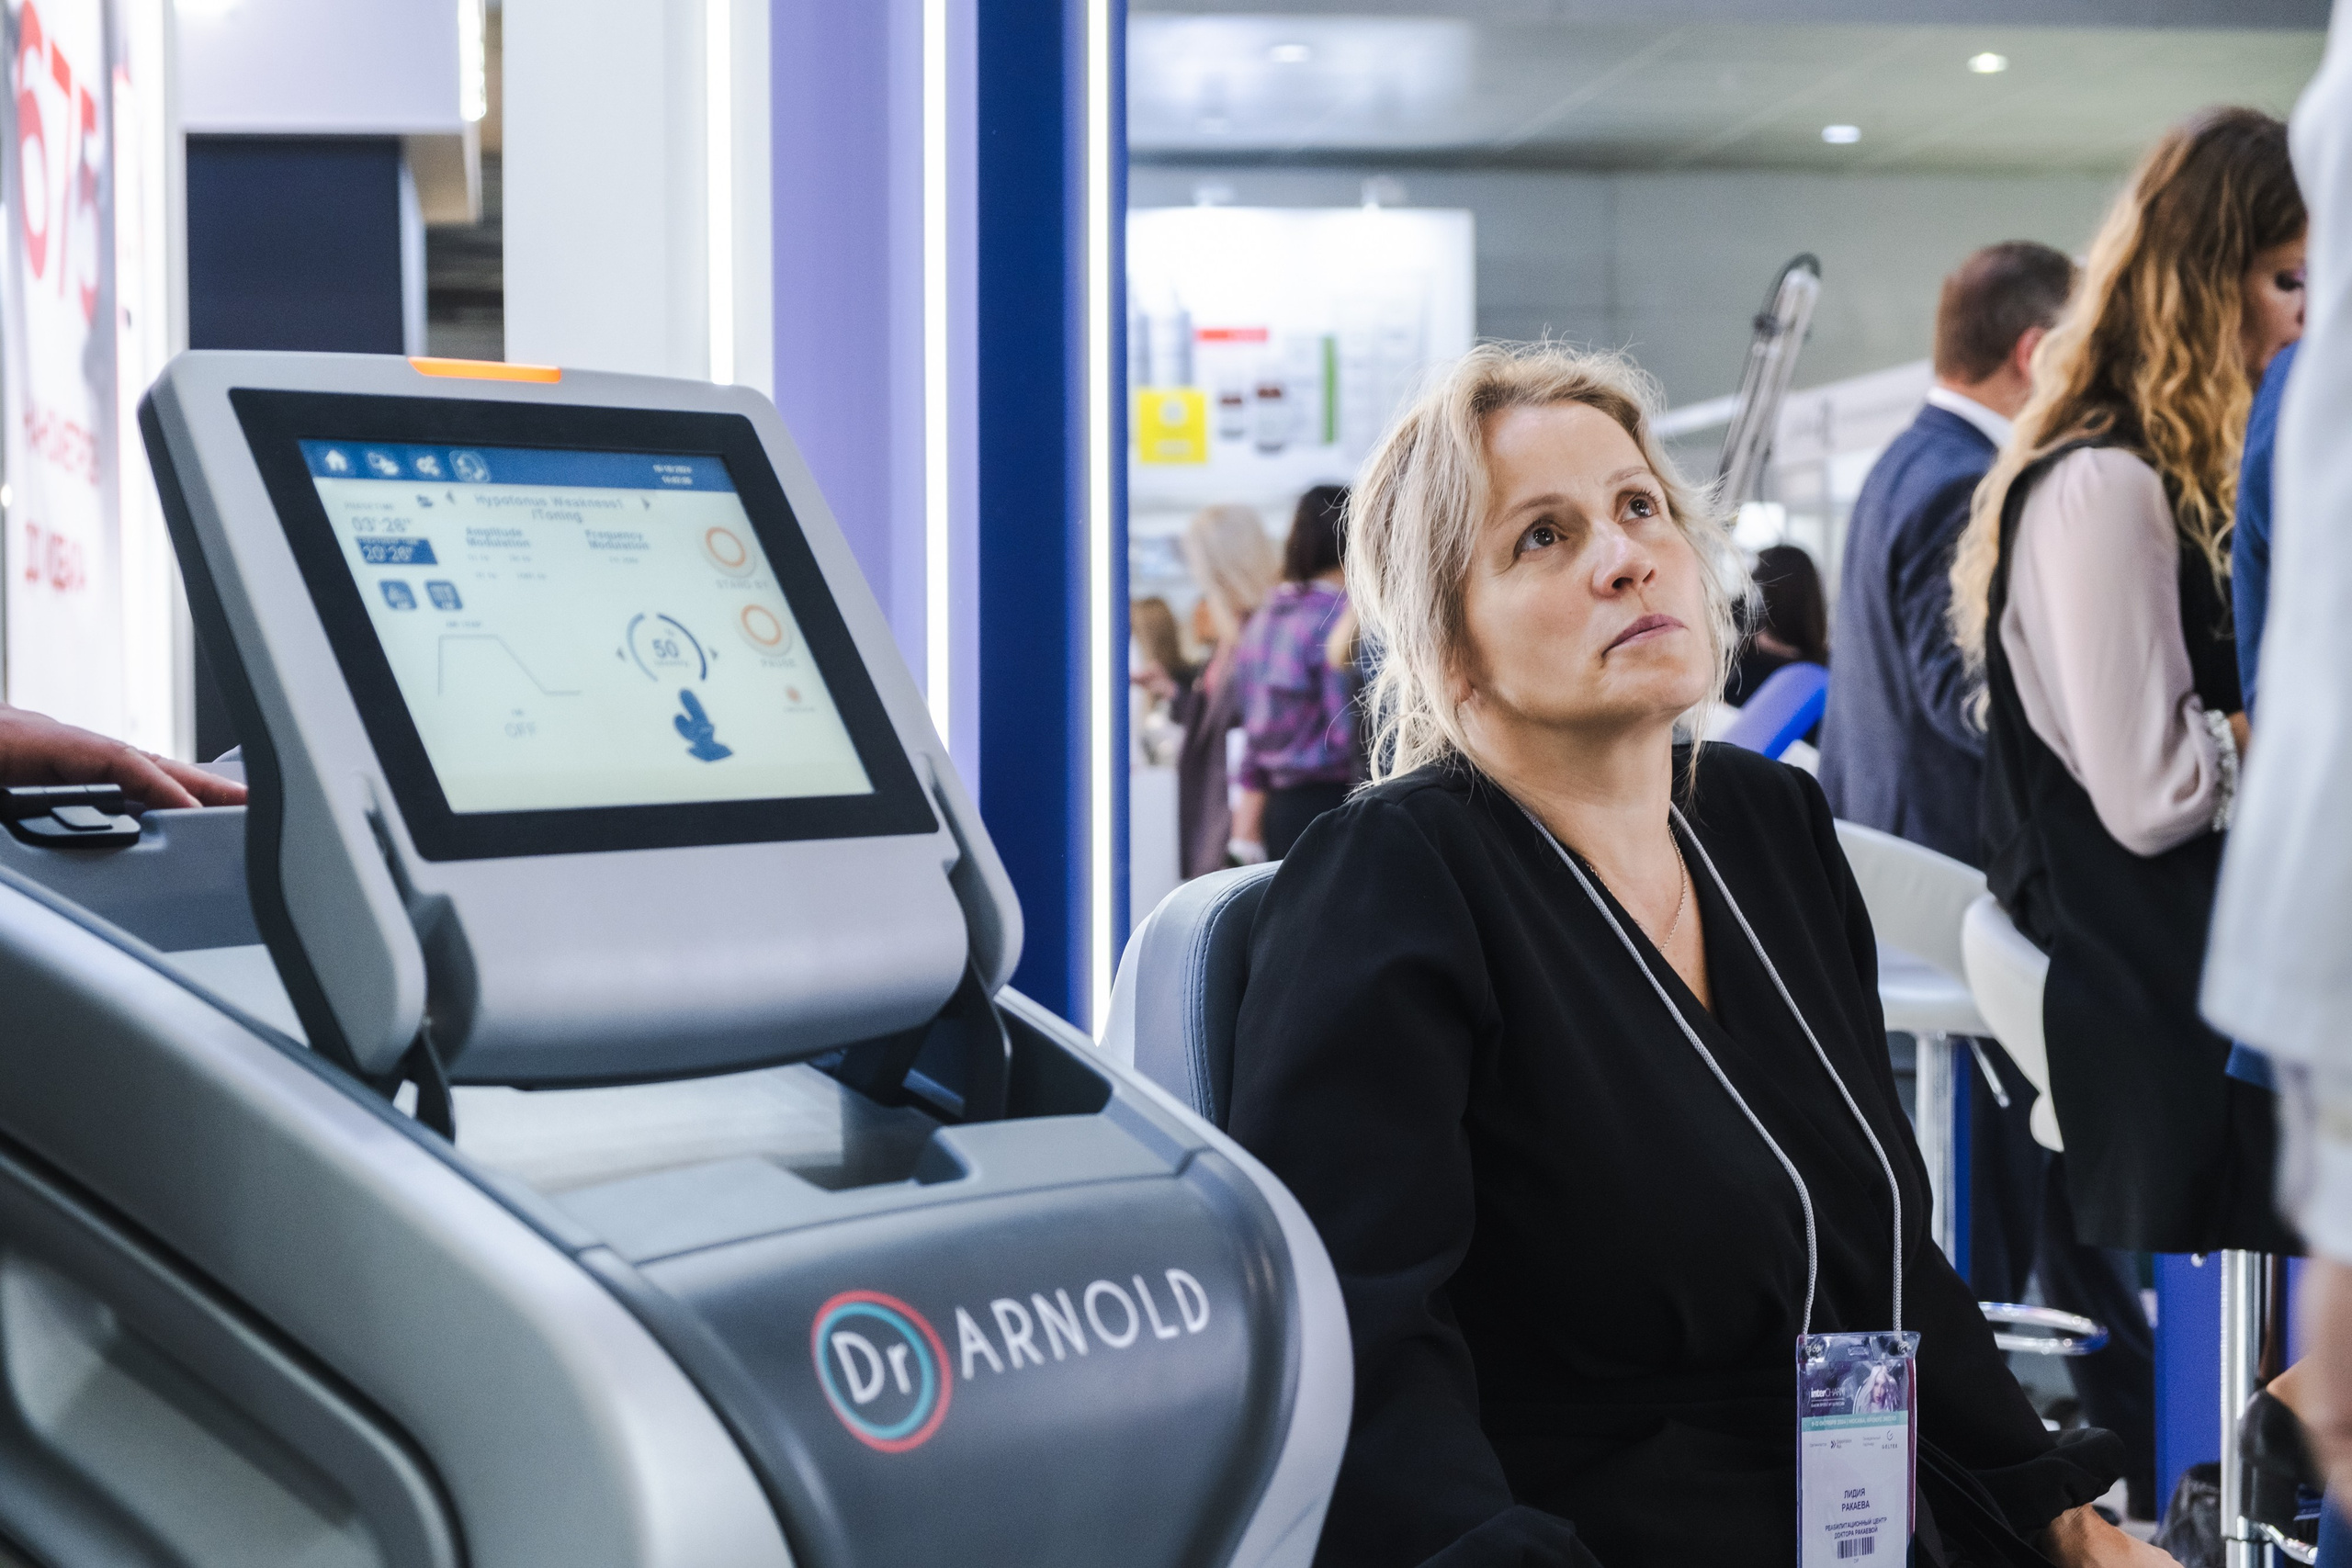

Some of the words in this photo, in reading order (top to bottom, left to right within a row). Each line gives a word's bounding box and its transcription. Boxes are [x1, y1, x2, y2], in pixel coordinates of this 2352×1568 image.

[465, 527, 525, 538] Amplitude
[584, 529, 643, 542] Frequency
[466, 537, 531, 548] Modulation
[589, 540, 650, 551] Modulation
[652, 638, 680, 660] 50
[503, 721, 537, 739] OFF
[831, 1331, 911, 1404] Dr
[956, 1268, 1211, 1380] ARNOLD
[1844, 1487, 1866, 1499] ЛИДИЯ
[1841, 1500, 1871, 1512] РАКАЕВА
[1825, 1518, 1872, 1531] РЕАБИЛИТАЦИОННЫЙ
[1872, 1517, 1888, 1526] ЦЕНТР
[1834, 1529, 1854, 1540] ДОКТОРА
[1855, 1526, 1878, 1535] РАКАЕВОЙ
